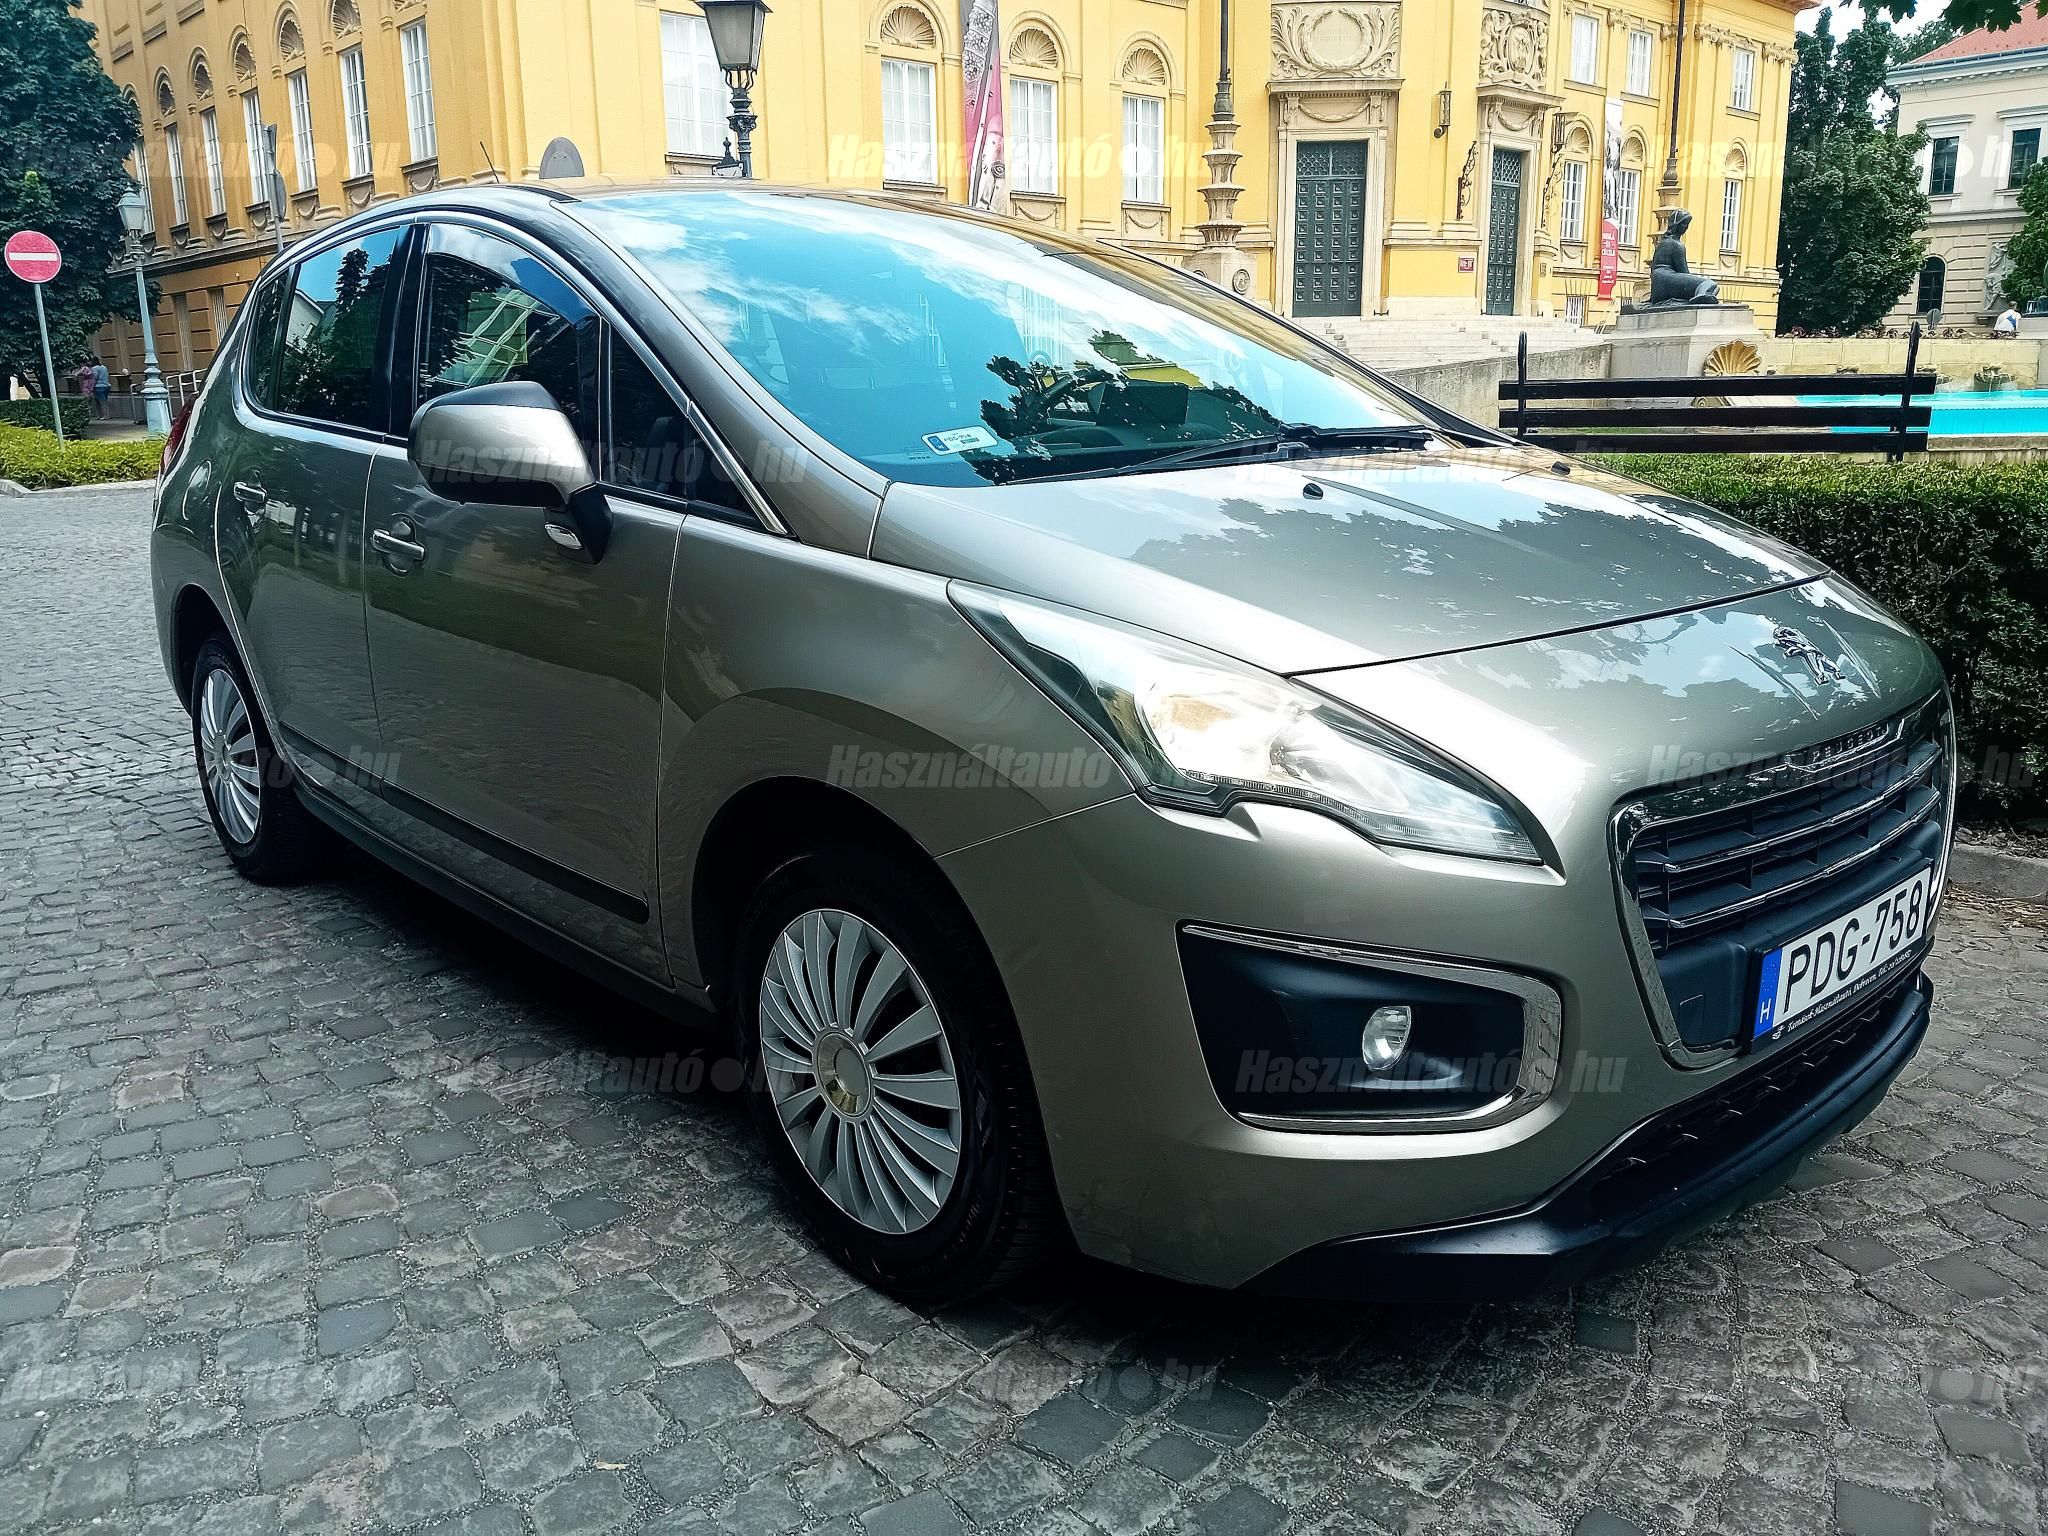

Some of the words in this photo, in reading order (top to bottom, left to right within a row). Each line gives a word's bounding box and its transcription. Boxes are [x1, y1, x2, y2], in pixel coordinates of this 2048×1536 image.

[1813, 726, 1882, 763] PEUGEOT
[1784, 879, 1923, 1014] PDG-758
[1759, 998, 1772, 1024] H
